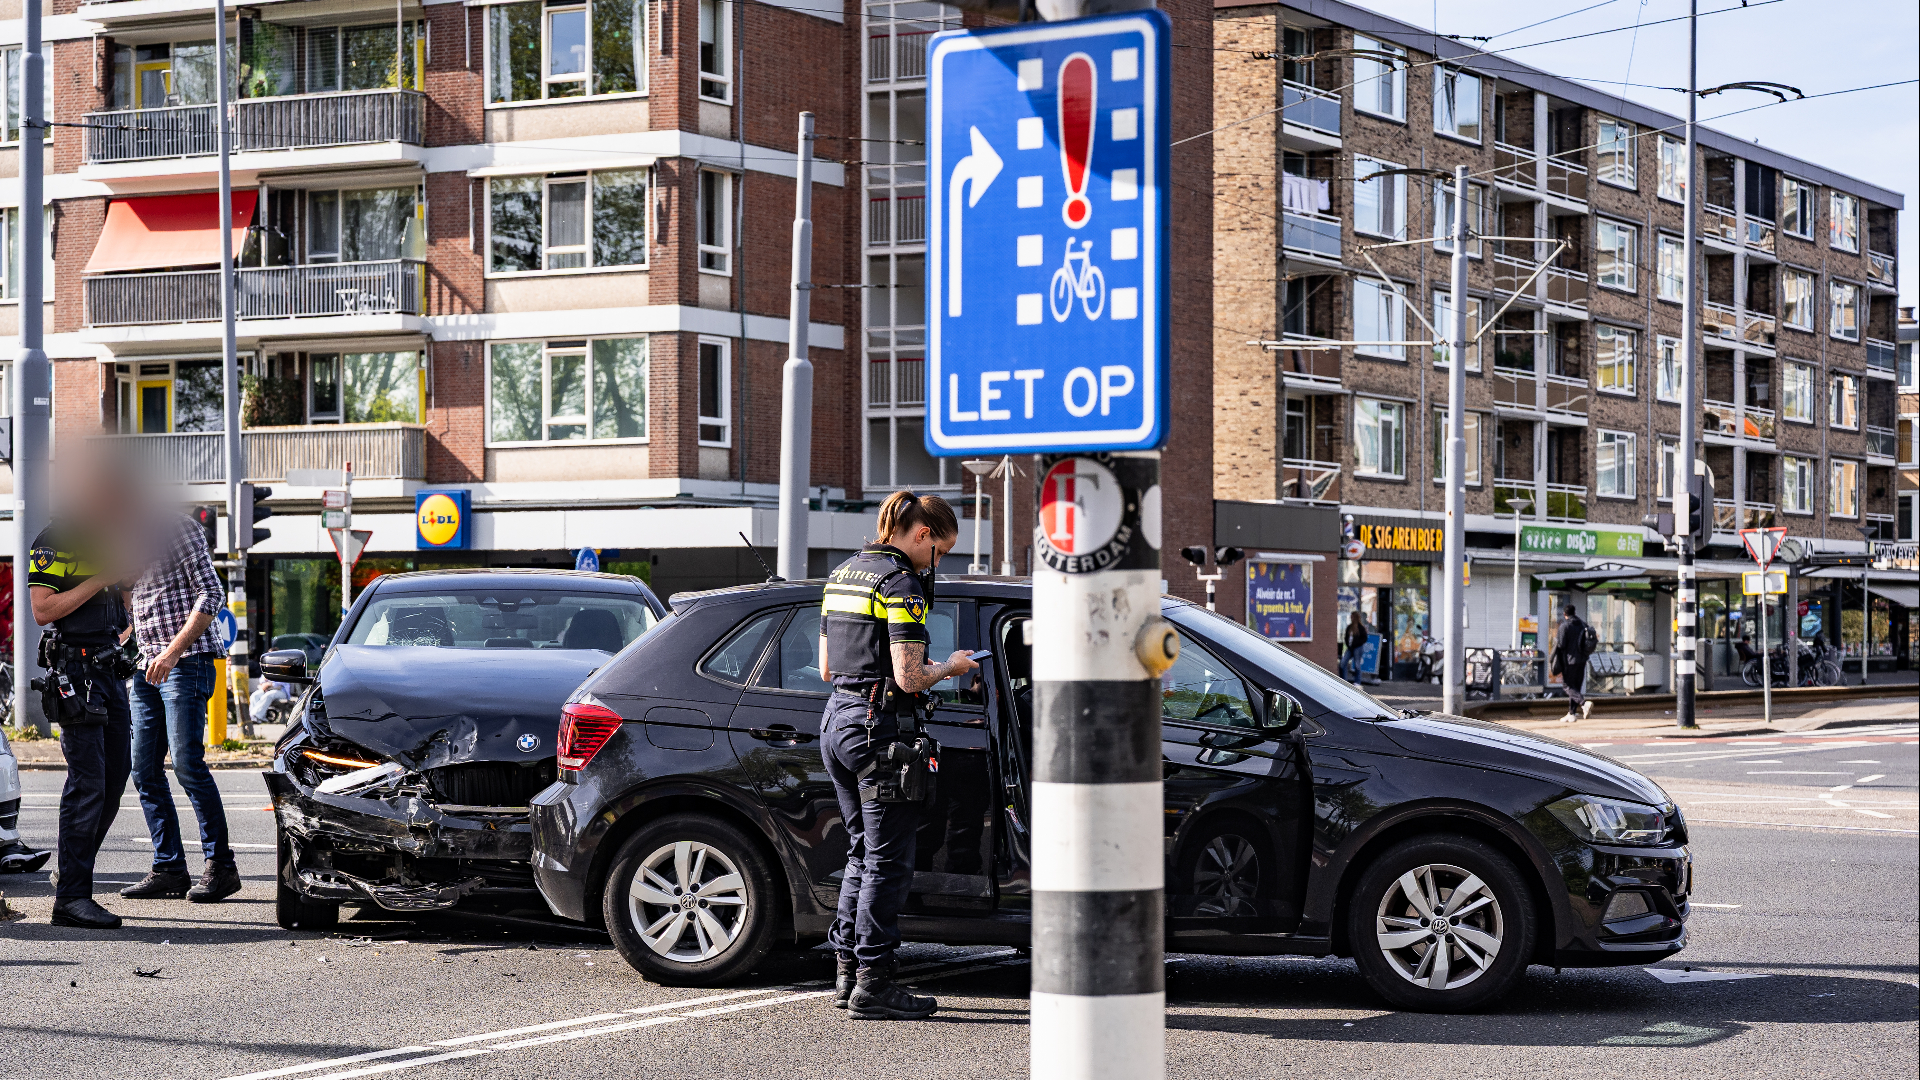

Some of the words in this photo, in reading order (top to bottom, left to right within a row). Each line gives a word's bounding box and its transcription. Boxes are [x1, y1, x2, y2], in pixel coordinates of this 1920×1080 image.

[949, 368, 1045, 422] LET
[1063, 365, 1136, 418] OP
[1360, 525, 1373, 549] DE
